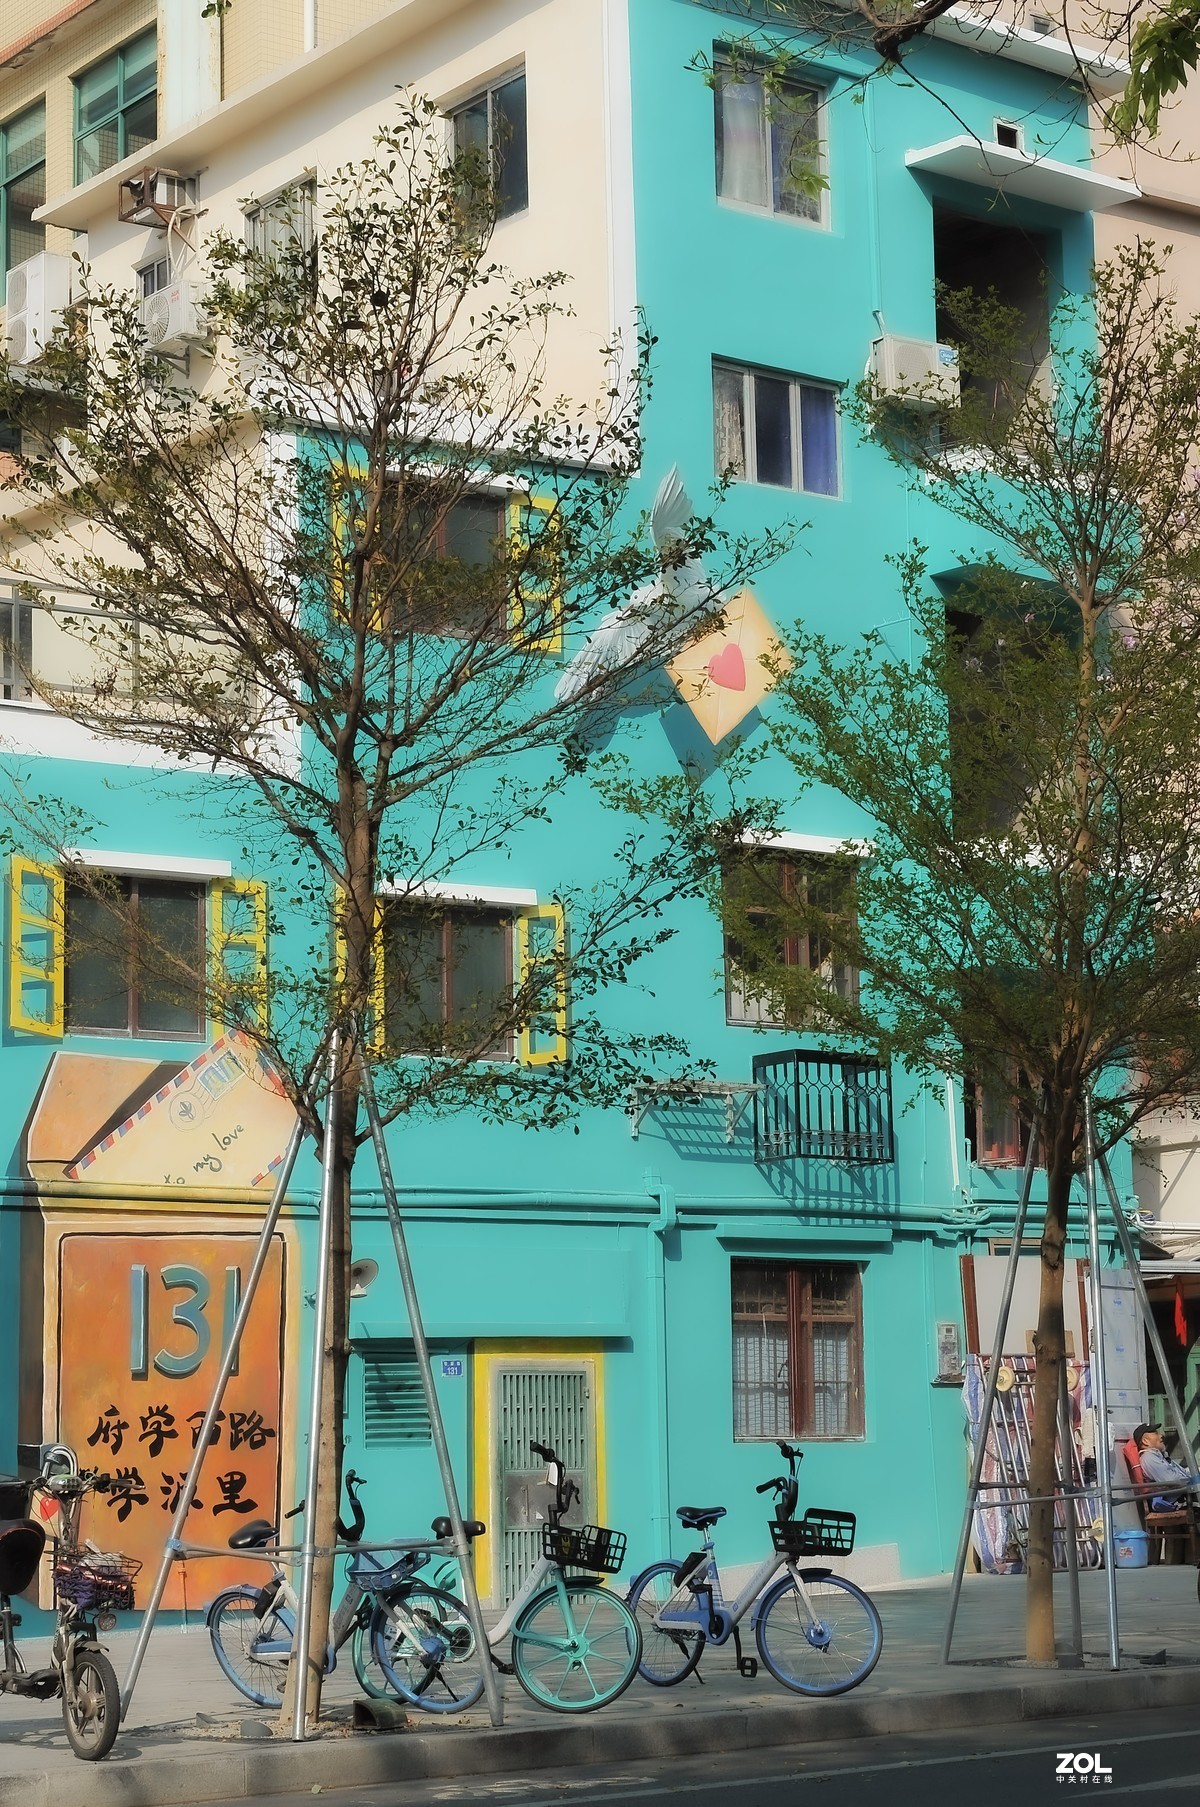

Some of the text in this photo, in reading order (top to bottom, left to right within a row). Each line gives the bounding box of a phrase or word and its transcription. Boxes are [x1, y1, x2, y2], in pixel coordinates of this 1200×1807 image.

[193, 1124, 244, 1172] my love
[130, 1264, 240, 1379] 131
[447, 1367, 458, 1375] 131
[87, 1404, 276, 1458] 府学西路
